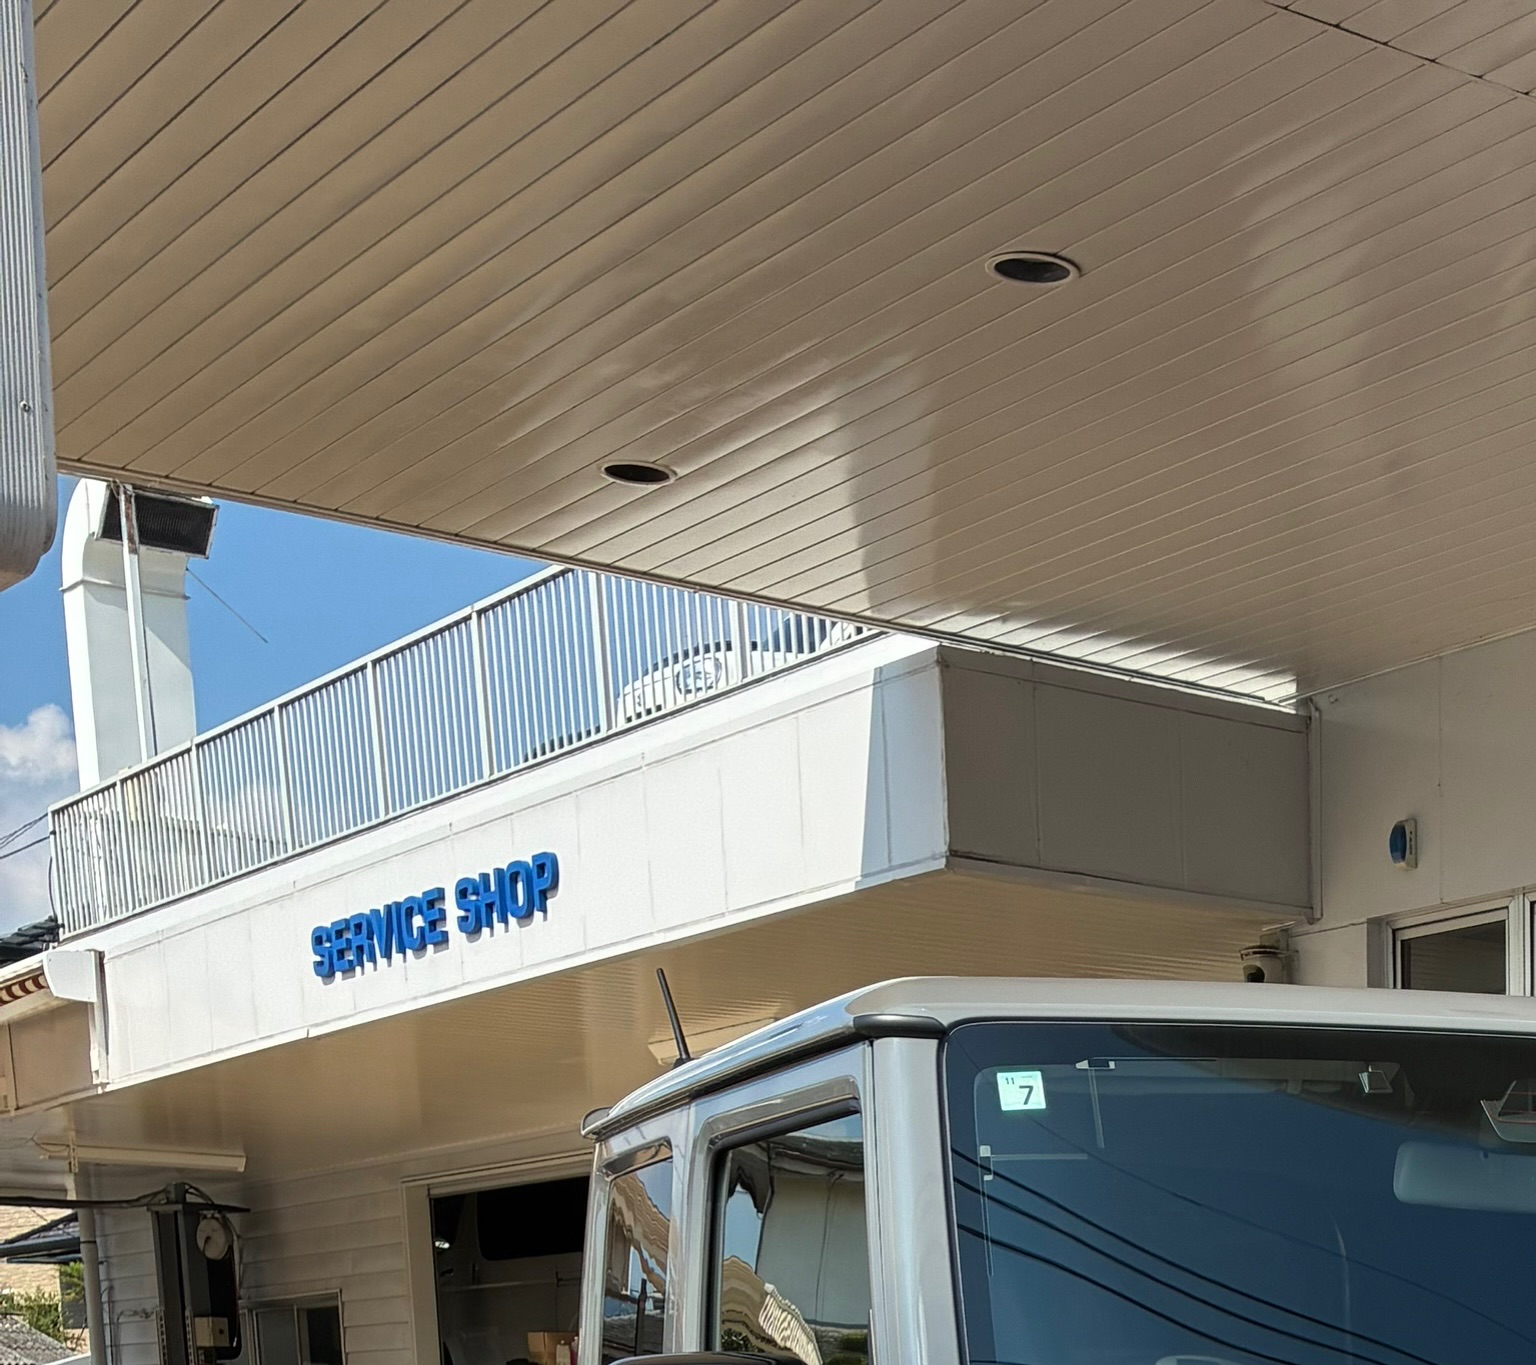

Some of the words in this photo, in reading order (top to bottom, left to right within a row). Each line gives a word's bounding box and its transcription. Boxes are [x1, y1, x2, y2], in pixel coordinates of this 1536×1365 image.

[311, 887, 449, 978] SERVICE
[455, 851, 560, 936] SHOP
[1019, 1085, 1034, 1105] 7
